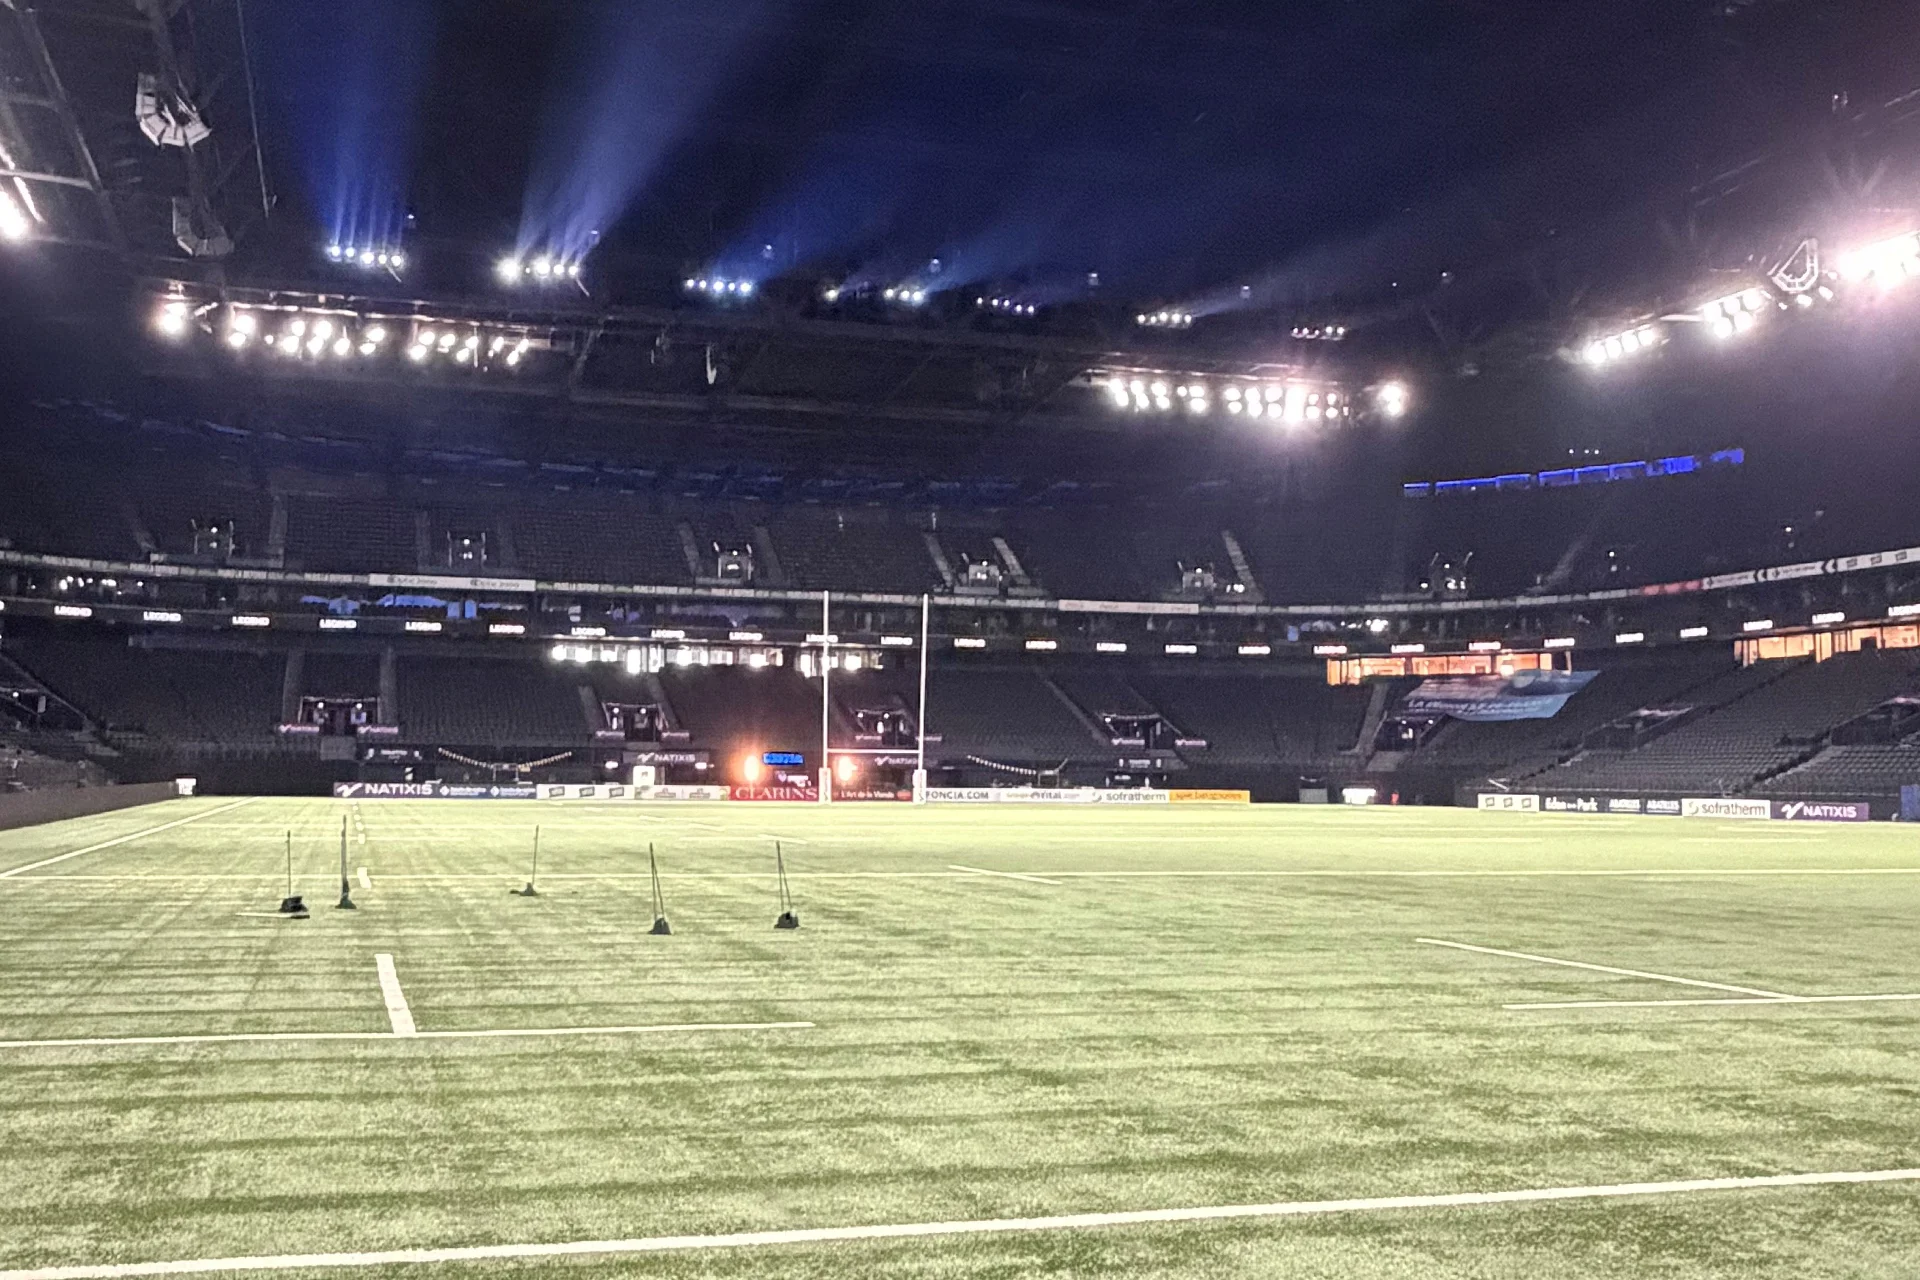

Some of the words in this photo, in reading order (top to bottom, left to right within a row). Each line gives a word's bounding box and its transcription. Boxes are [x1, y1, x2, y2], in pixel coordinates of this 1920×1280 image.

[364, 783, 433, 796] NATIXIS
[735, 787, 818, 800] CLARINS
[1106, 792, 1166, 801] sofratherm
[1701, 803, 1766, 816] sofratherm
[1803, 805, 1857, 818] NATIXIS
